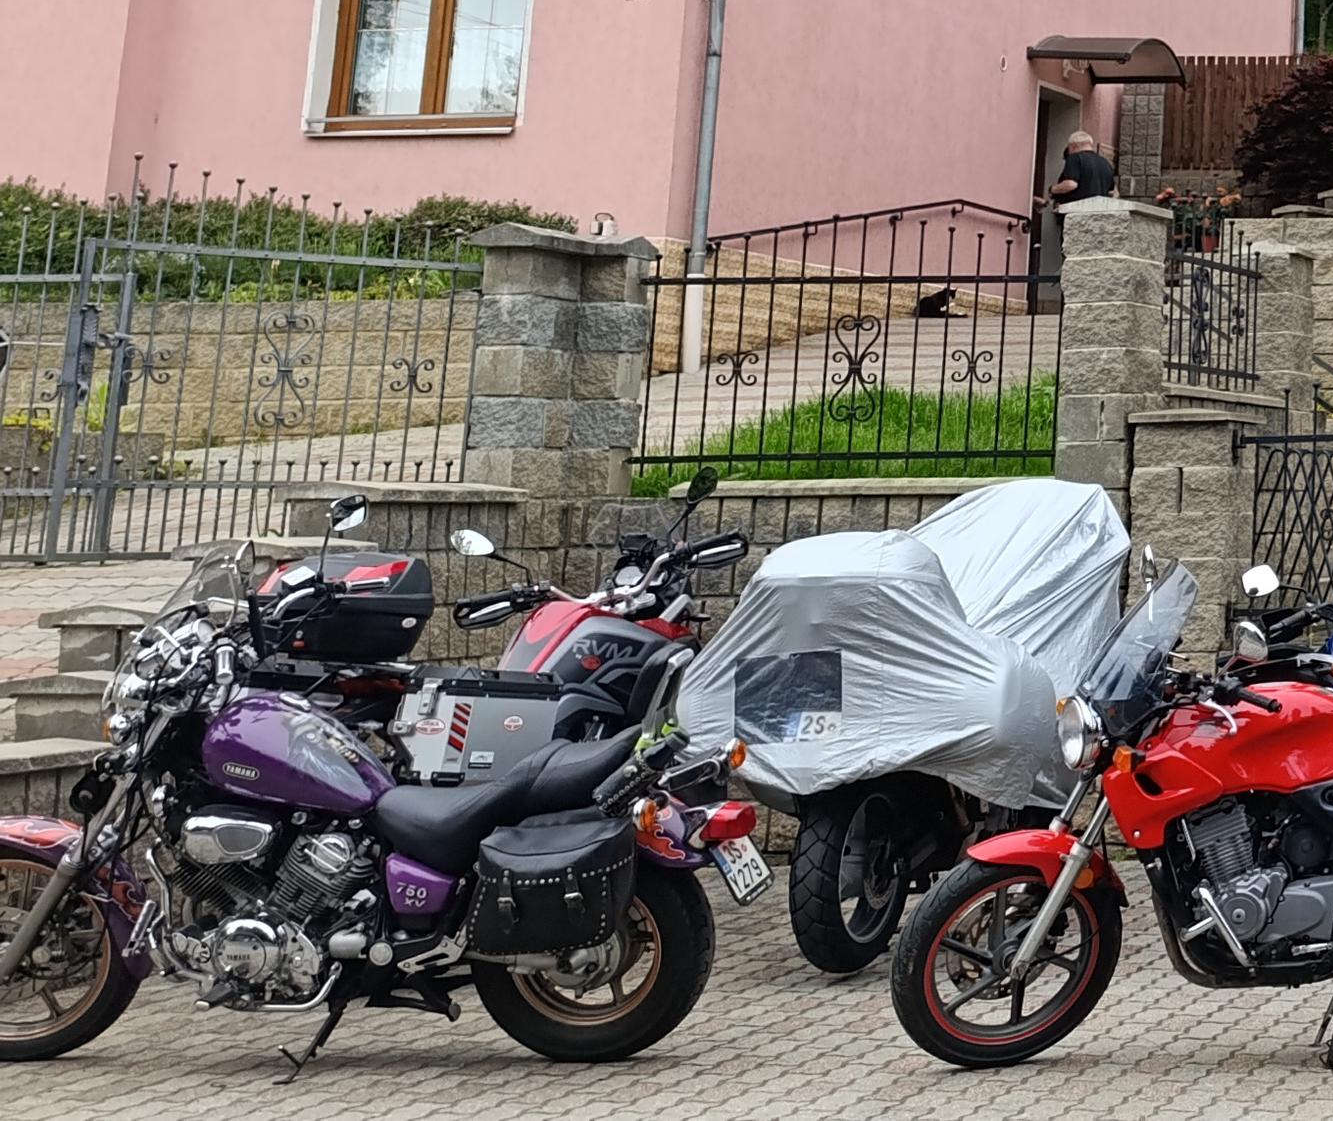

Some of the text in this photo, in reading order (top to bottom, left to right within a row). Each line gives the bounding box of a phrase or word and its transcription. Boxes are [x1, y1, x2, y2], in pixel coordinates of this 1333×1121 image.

[572, 638, 634, 659] RVM
[801, 715, 826, 735] 2S
[226, 765, 256, 778] YAMAHA
[729, 858, 763, 893] Y279
[396, 881, 427, 899] 750
[404, 897, 426, 908] XV
